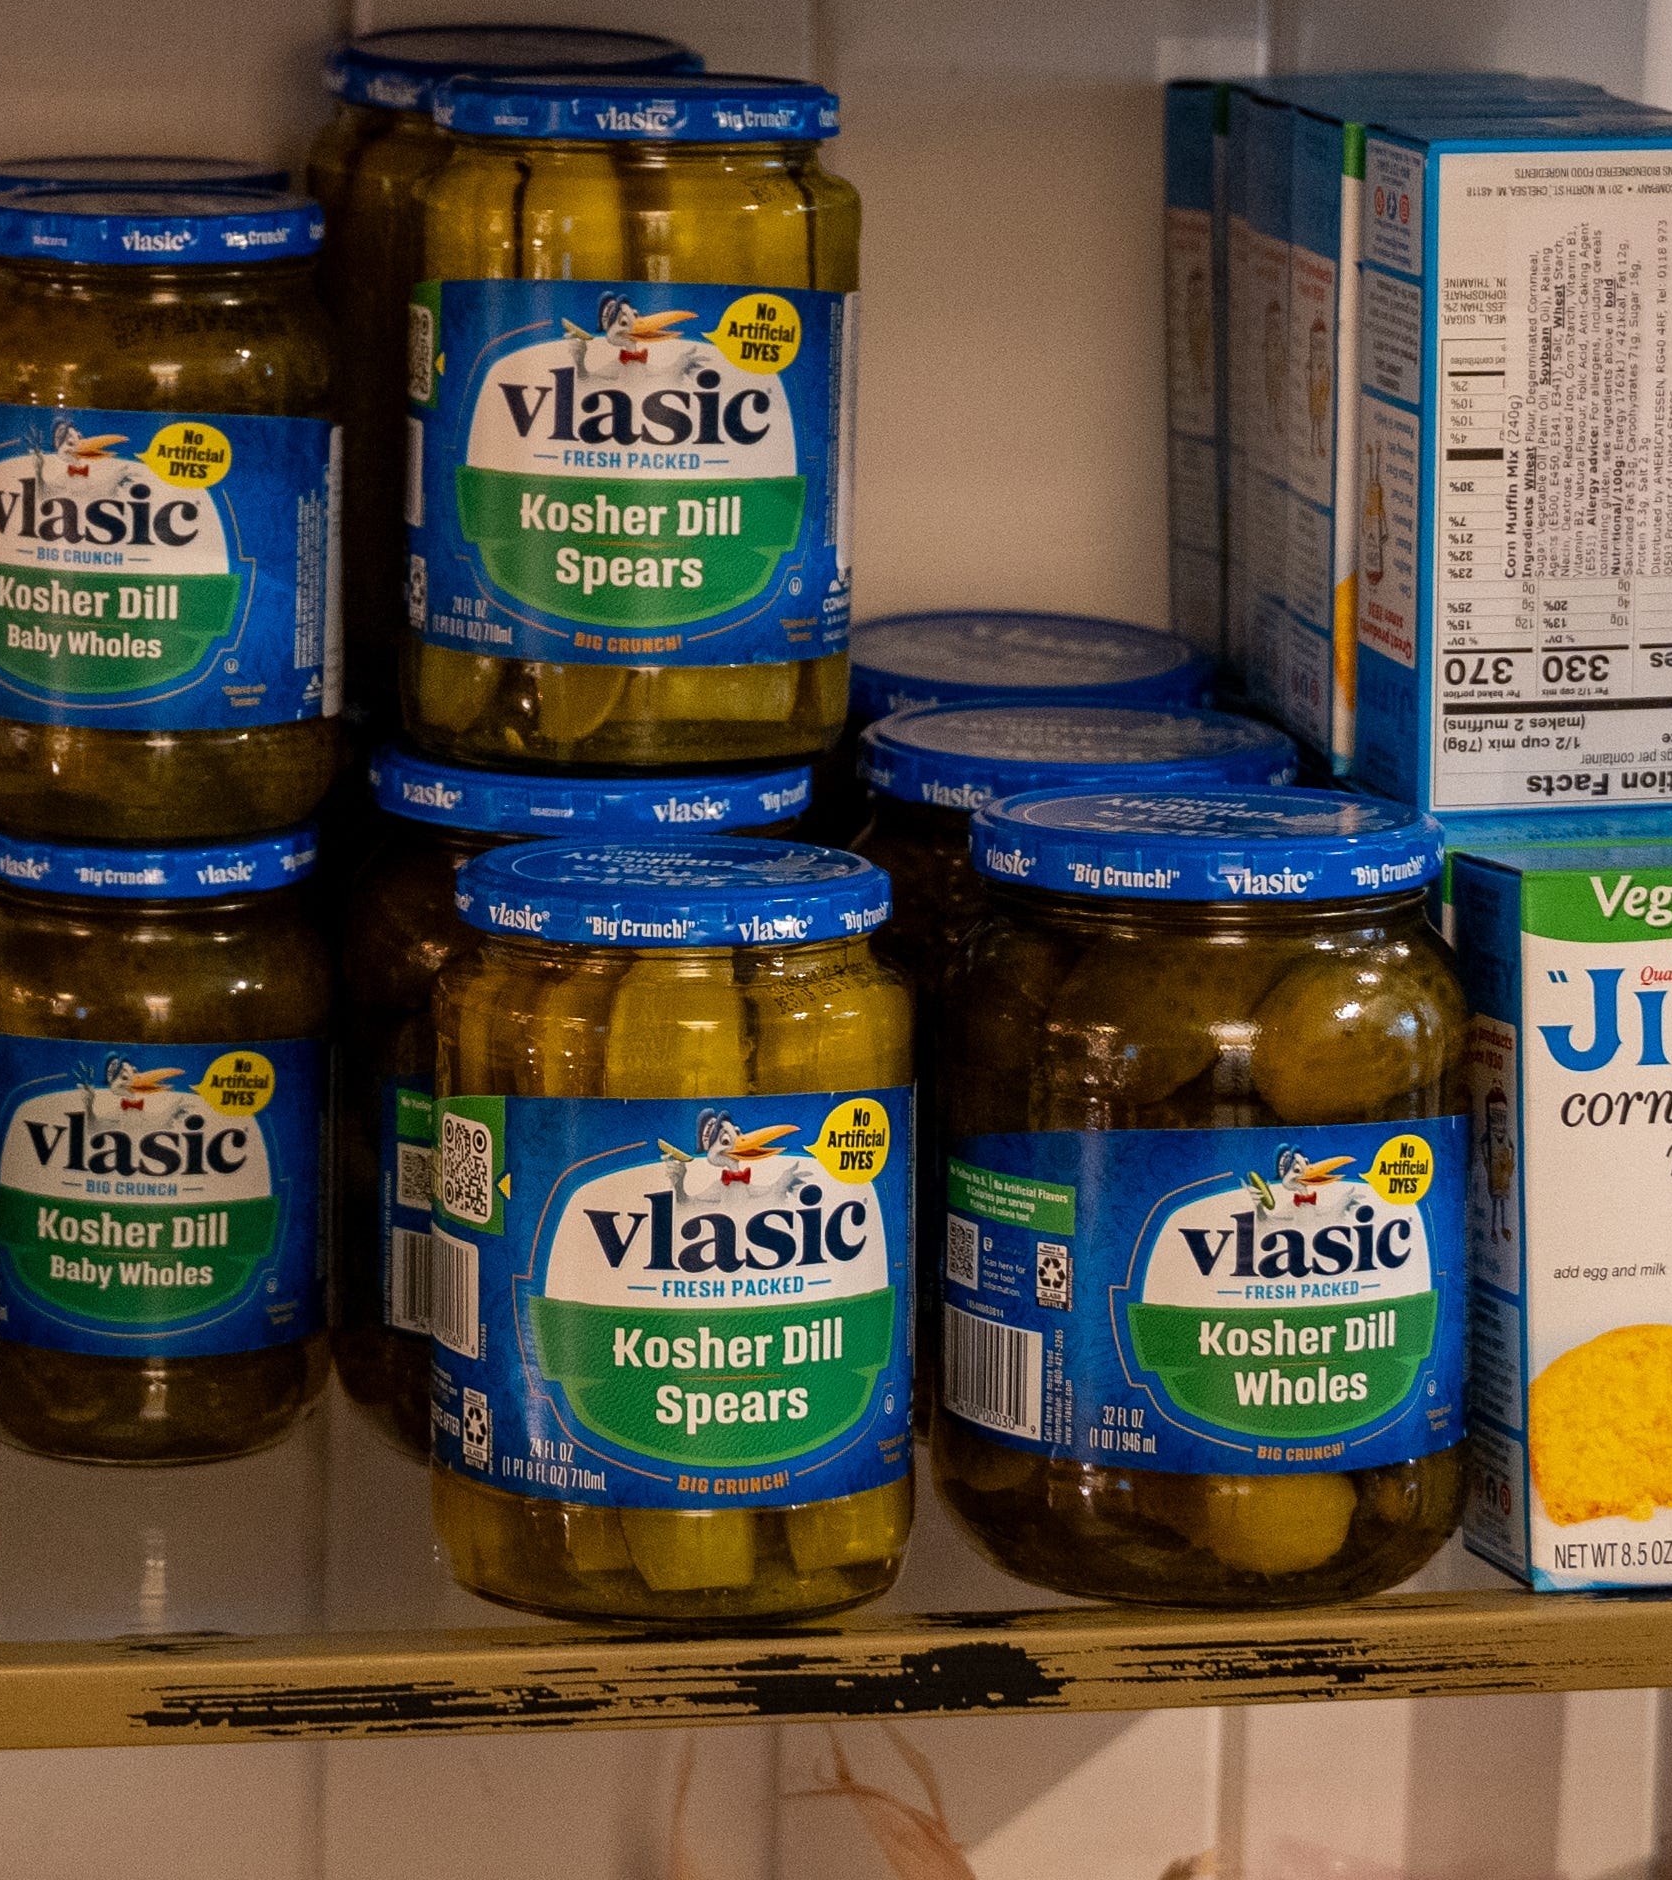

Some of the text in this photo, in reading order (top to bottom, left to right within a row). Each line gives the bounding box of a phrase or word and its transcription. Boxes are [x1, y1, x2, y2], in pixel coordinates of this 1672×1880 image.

[183, 429, 204, 445] No
[157, 444, 224, 465] Artificial
[169, 462, 208, 479] DYES
[1505, 394, 1522, 578] Corn Muffin Mix (240g)
[118, 584, 178, 619] Dill
[7, 625, 161, 658] Baby Wholes
[1444, 656, 1514, 686] 370
[1542, 655, 1610, 682] 330
[1526, 771, 1609, 796] Facts
[1226, 867, 1307, 895] vlasic
[584, 1184, 867, 1273] vlasic
[1180, 1205, 1412, 1278] vlasic
[1554, 1262, 1666, 1280] add egg and milk
[662, 1276, 803, 1298] FRESH PACKED
[613, 1317, 842, 1369] Kosher Dill
[1199, 1311, 1396, 1355] Kosher Dill
[1234, 1368, 1367, 1406] Wholes
[655, 1384, 808, 1434] Spears
[678, 1471, 789, 1494] BIG CRUNCH!
[1554, 1540, 1672, 1569] NET WT 8.5 OZ
